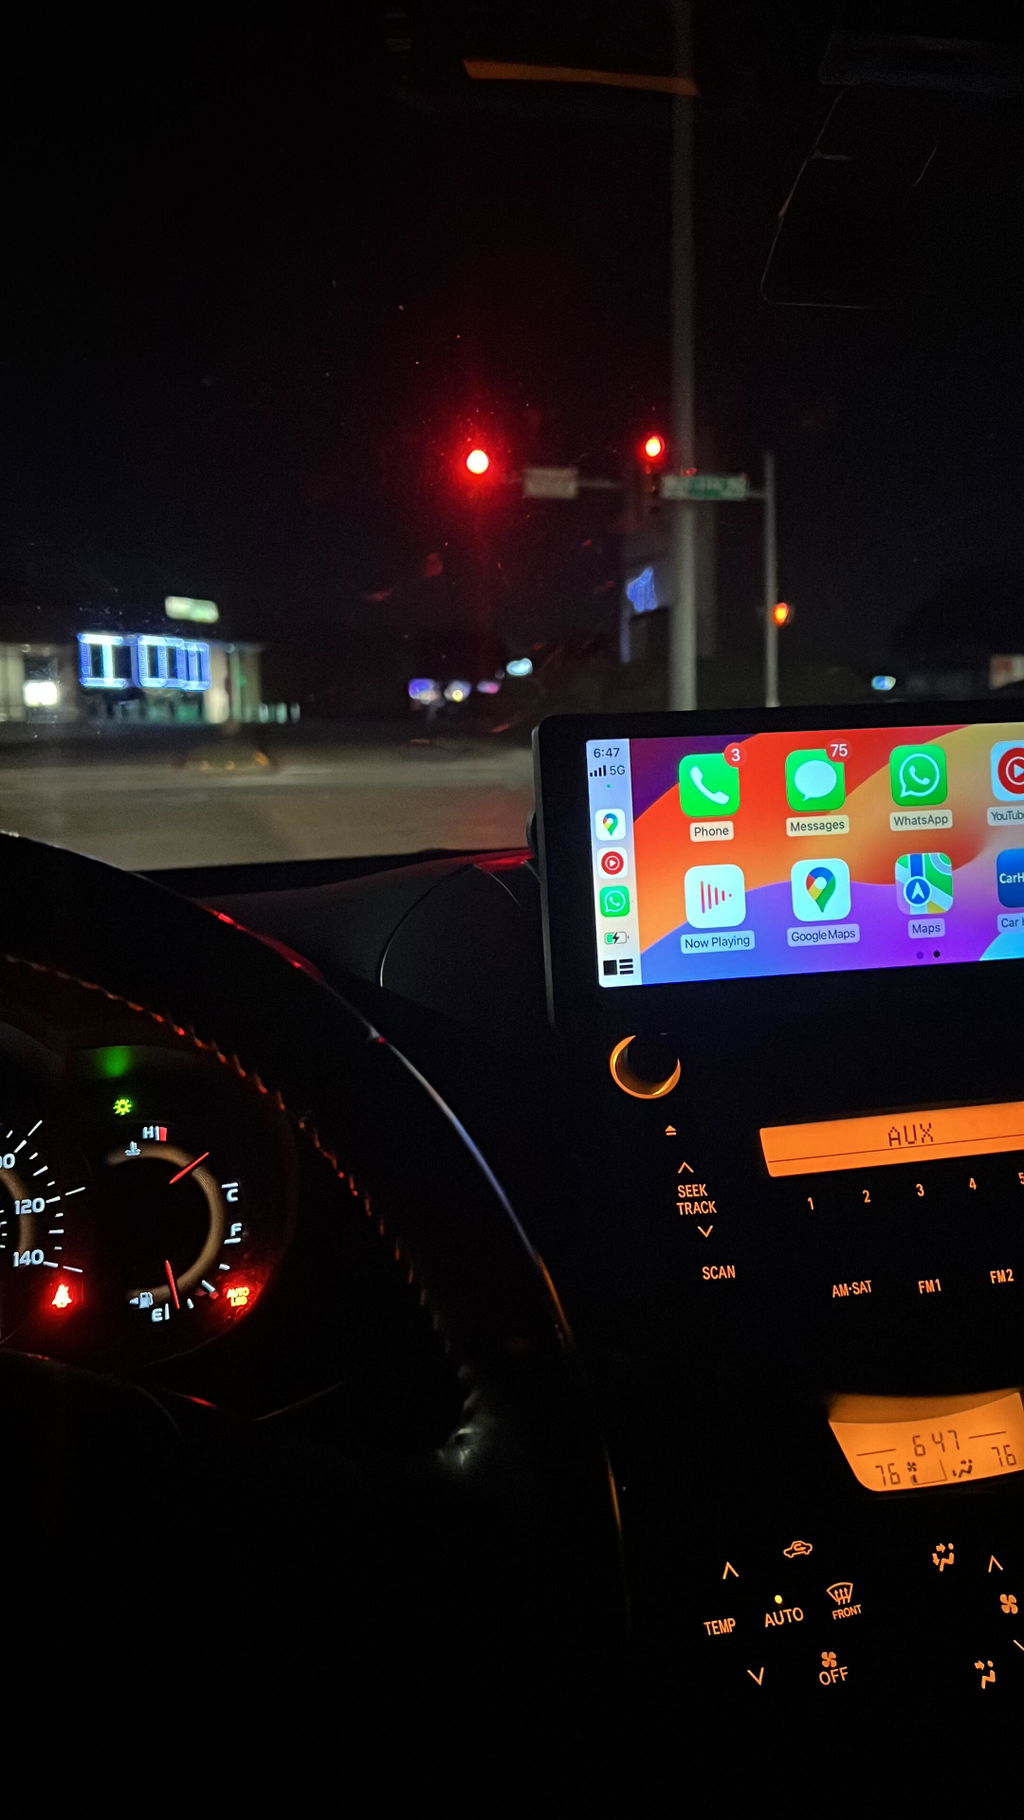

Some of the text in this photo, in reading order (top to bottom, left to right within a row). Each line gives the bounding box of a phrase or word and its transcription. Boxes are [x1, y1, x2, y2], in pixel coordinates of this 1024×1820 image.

[593, 747, 620, 759] 6:47
[730, 749, 740, 762] 3
[830, 743, 848, 758] 75
[609, 765, 626, 776] 5G
[790, 820, 845, 834] Messages
[894, 812, 948, 827] WhatsApp
[694, 826, 729, 839] Phone
[912, 923, 941, 936] Maps
[1001, 918, 1019, 928] Car
[684, 934, 750, 949] Now Playing
[791, 929, 856, 943] Google Maps
[888, 1123, 934, 1147] AUX
[677, 1184, 708, 1198] SEEK
[916, 1183, 925, 1197] 3
[968, 1178, 977, 1191] 4
[226, 1188, 238, 1202] C
[863, 1190, 871, 1204] 2
[15, 1197, 45, 1215] 120
[676, 1200, 717, 1216] TRACK
[807, 1197, 814, 1210] 1
[230, 1222, 242, 1236] F
[13, 1249, 44, 1267] 140
[702, 1265, 736, 1281] SCAN
[990, 1268, 1015, 1285] FM2
[918, 1278, 942, 1294] FM1
[991, 1444, 1017, 1467] 76
[875, 1462, 900, 1486] 76
[765, 1607, 804, 1628] AUTO
[832, 1604, 862, 1620] FRONT
[703, 1617, 736, 1636] TEMP
[819, 1666, 848, 1686] OFF
